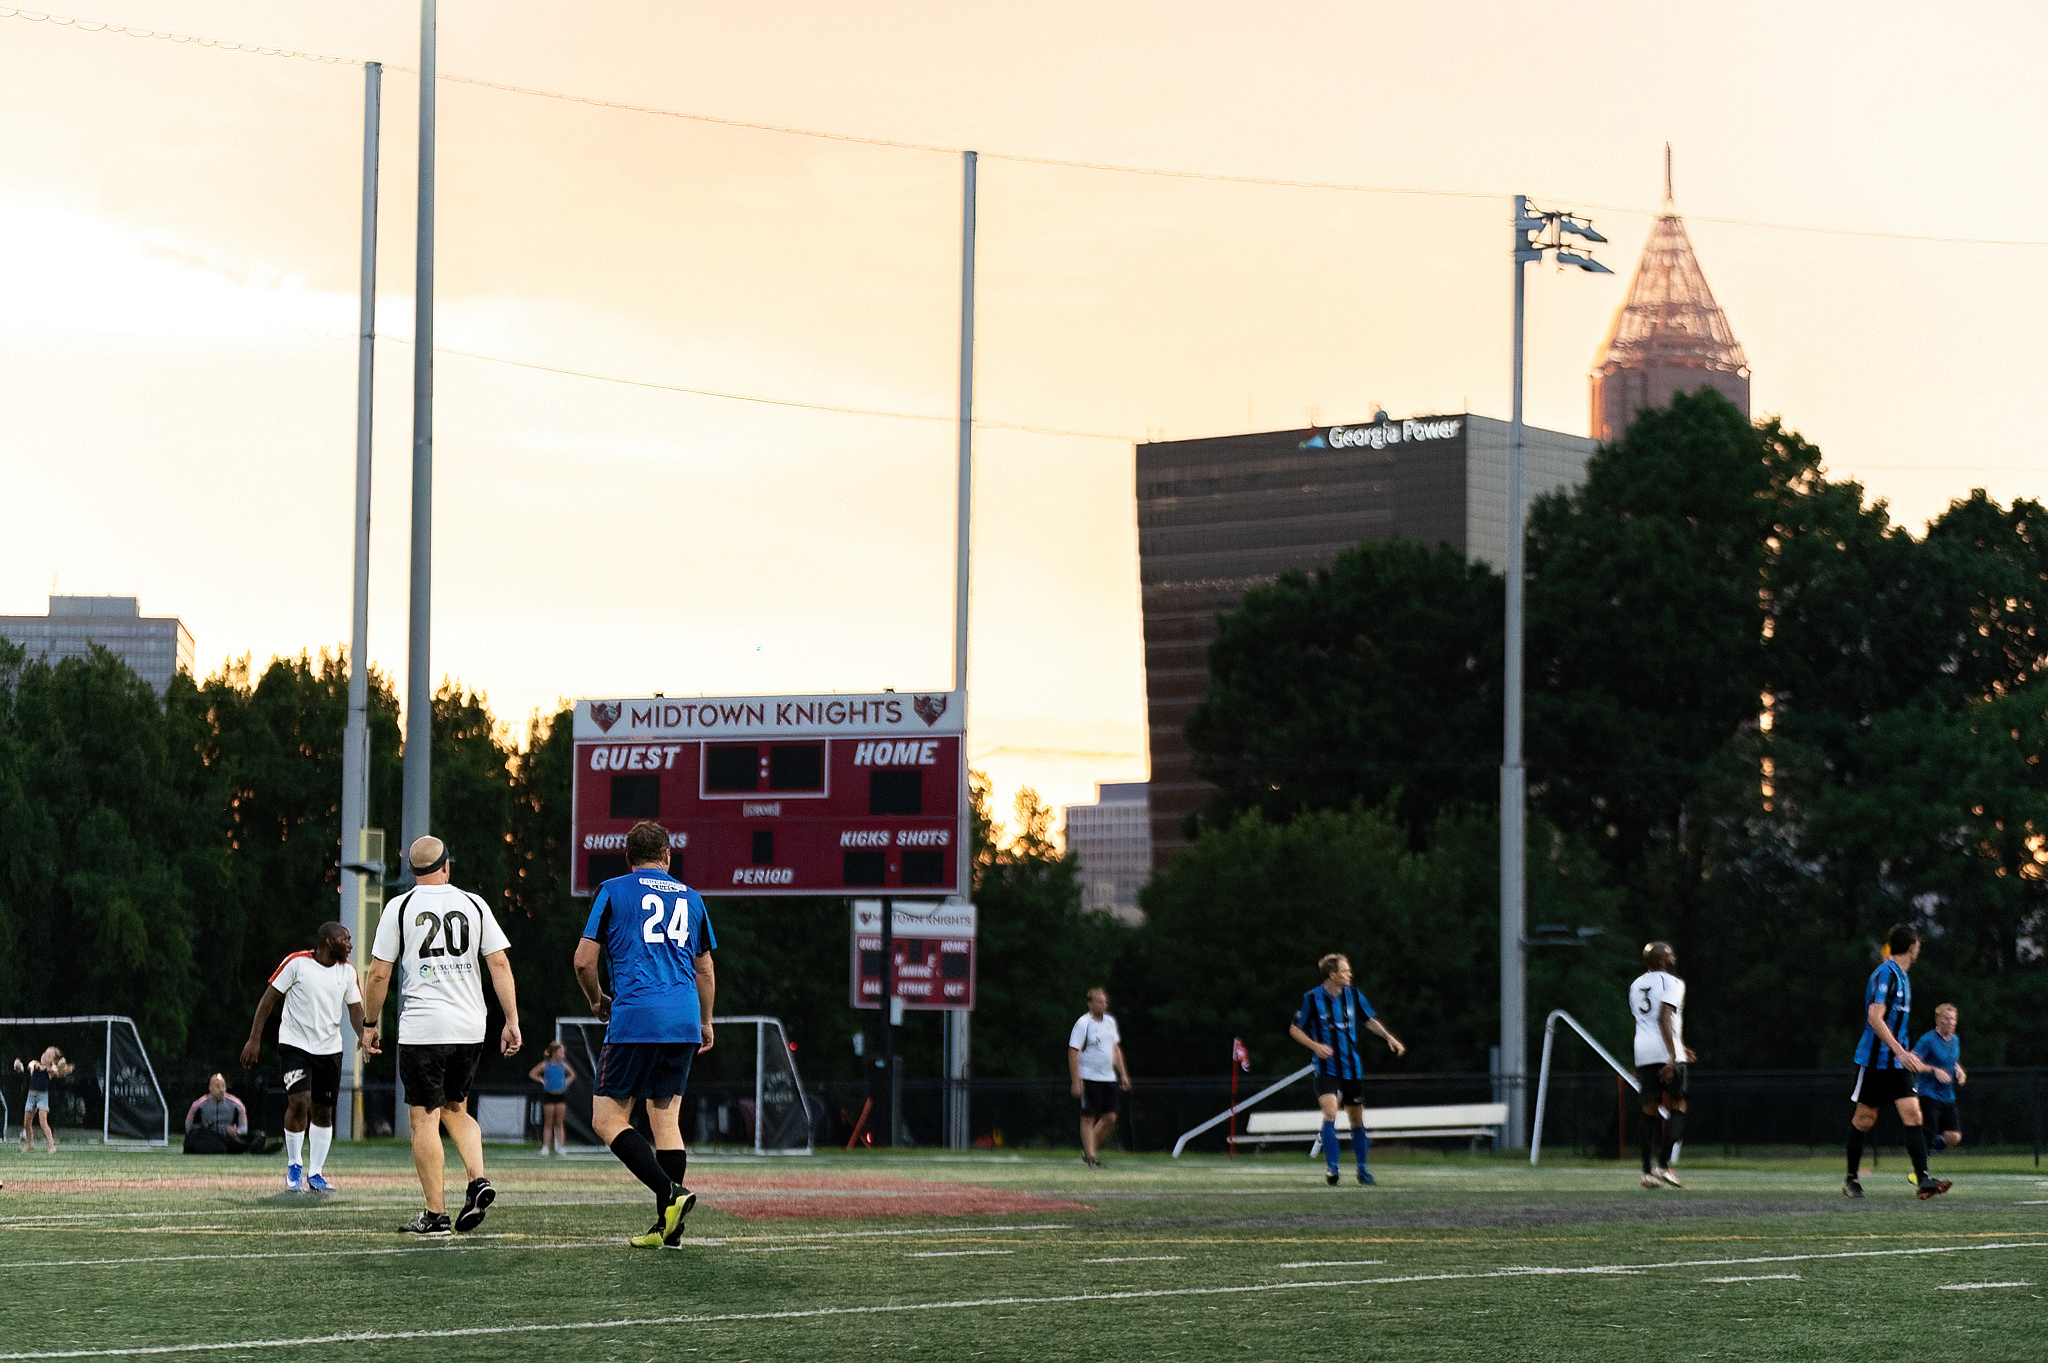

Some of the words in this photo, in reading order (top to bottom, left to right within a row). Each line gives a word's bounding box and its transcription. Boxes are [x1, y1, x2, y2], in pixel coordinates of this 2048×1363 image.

[1328, 422, 1401, 450] Georgia
[1402, 419, 1463, 443] Power
[631, 703, 765, 729] MIDTOWN
[775, 700, 903, 726] KNIGHTS
[590, 746, 681, 771] GUEST
[853, 740, 939, 767] HOME
[840, 830, 891, 847] KICKS
[896, 829, 950, 846] SHOTS
[732, 868, 794, 885] PERIOD
[641, 893, 690, 948] 24
[415, 910, 470, 960] 20
[1637, 986, 1652, 1015] 3
